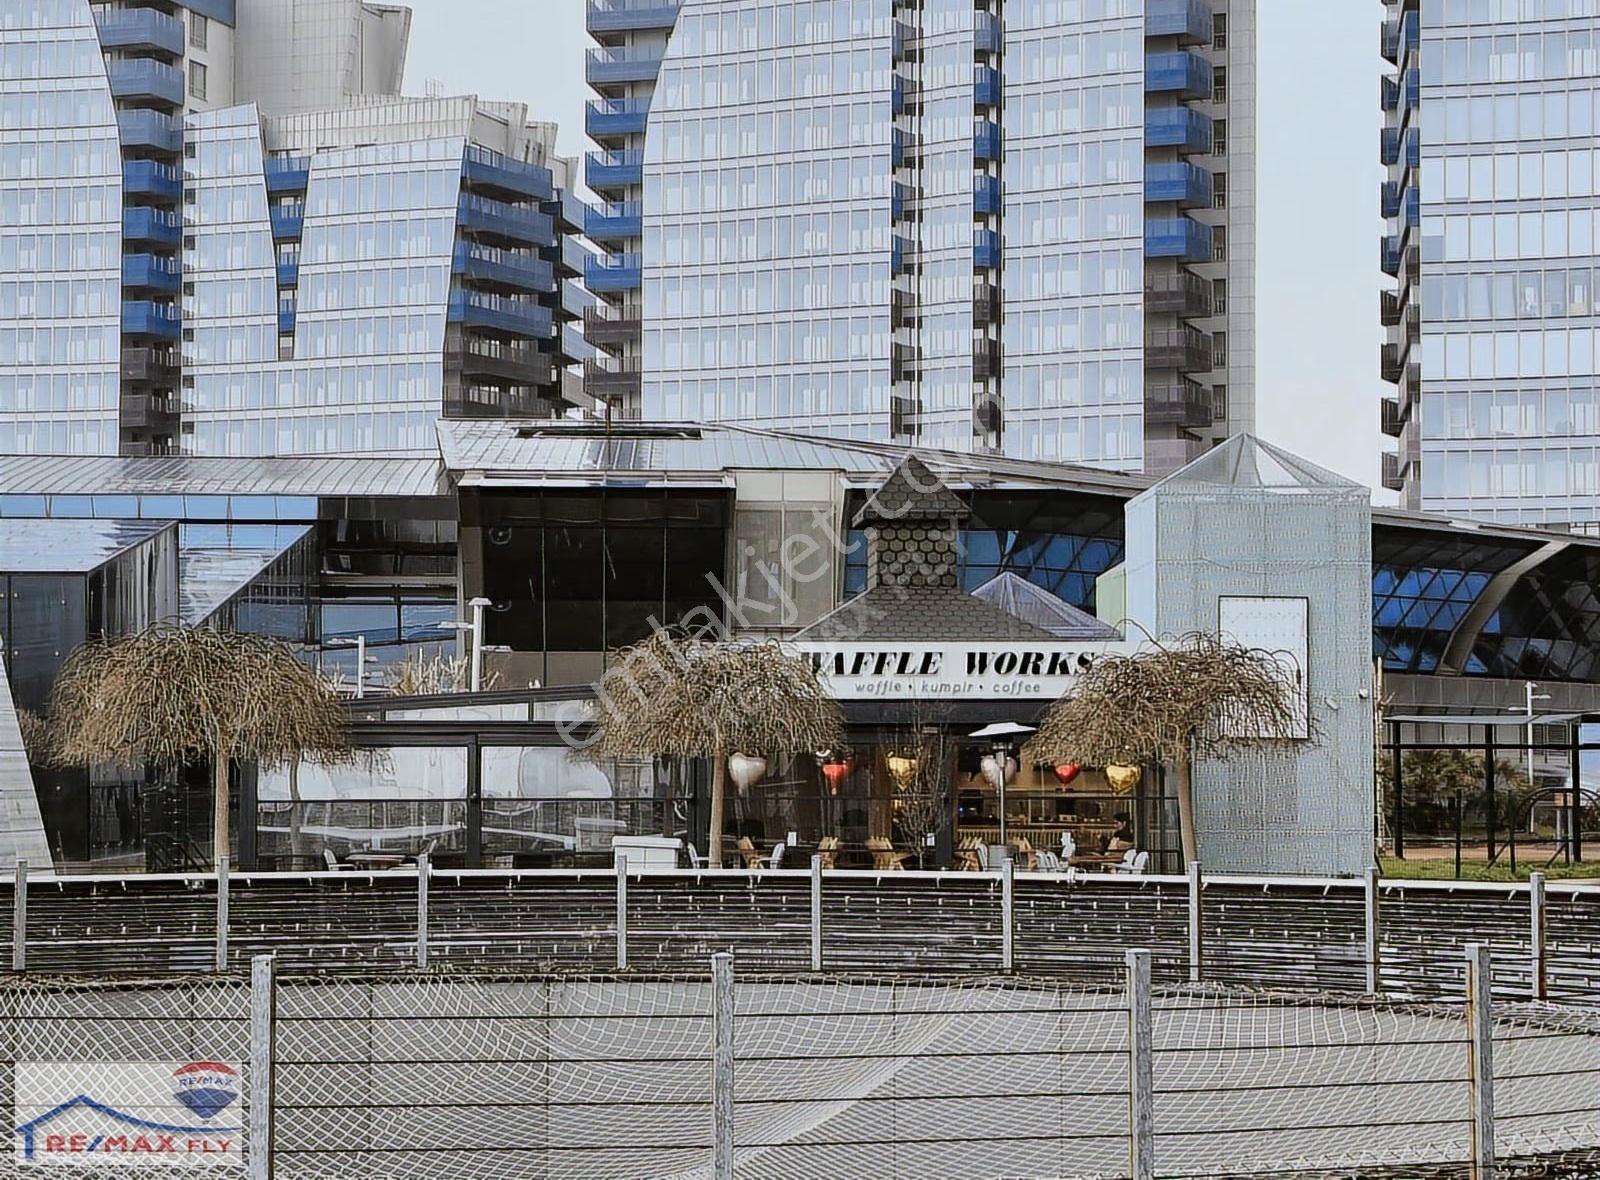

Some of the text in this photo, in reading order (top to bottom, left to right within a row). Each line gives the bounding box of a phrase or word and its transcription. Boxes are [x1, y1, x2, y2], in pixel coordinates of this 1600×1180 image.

[966, 651, 1096, 676] WORKS
[855, 681, 902, 695] waffle
[992, 681, 1041, 695] coffee
